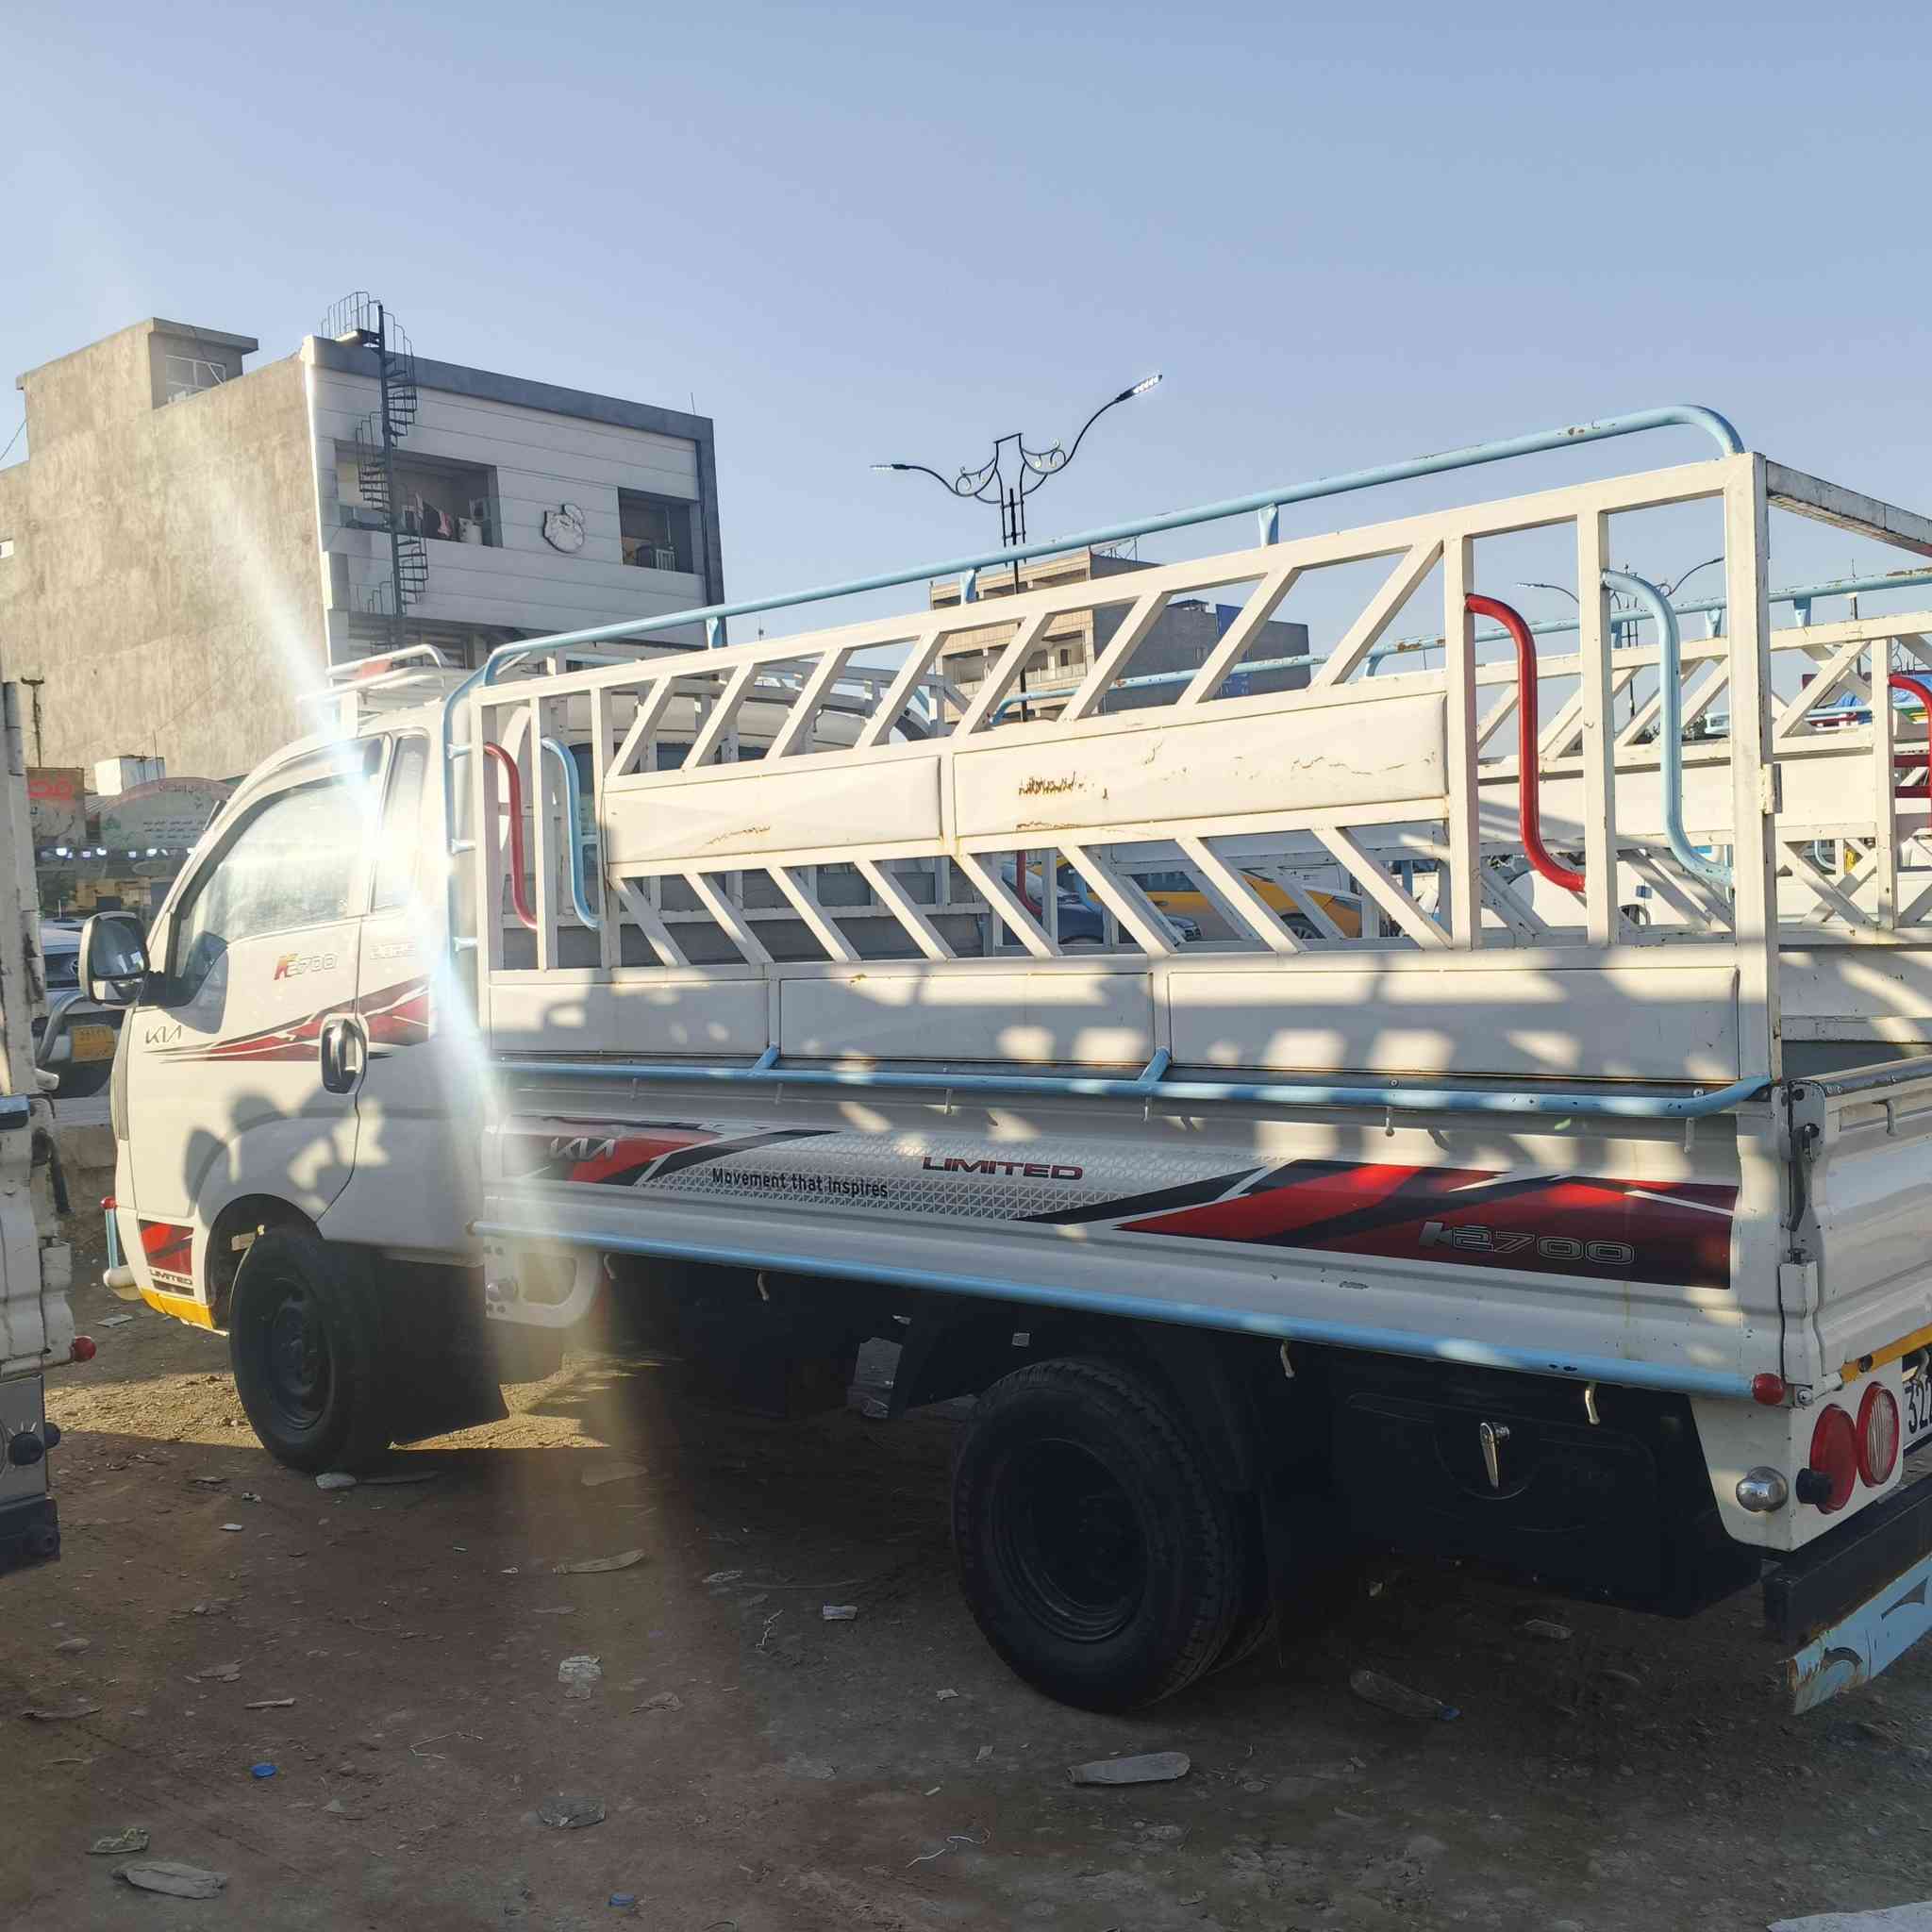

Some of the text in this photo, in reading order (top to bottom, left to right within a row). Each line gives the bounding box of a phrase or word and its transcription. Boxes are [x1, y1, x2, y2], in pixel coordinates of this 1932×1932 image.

[145, 1024, 182, 1043] KIA
[549, 1137, 616, 1160] KIA
[922, 1156, 1084, 1181] LIMITED
[711, 1167, 890, 1199] Movement that inspires
[149, 1268, 193, 1286] LIMITED
